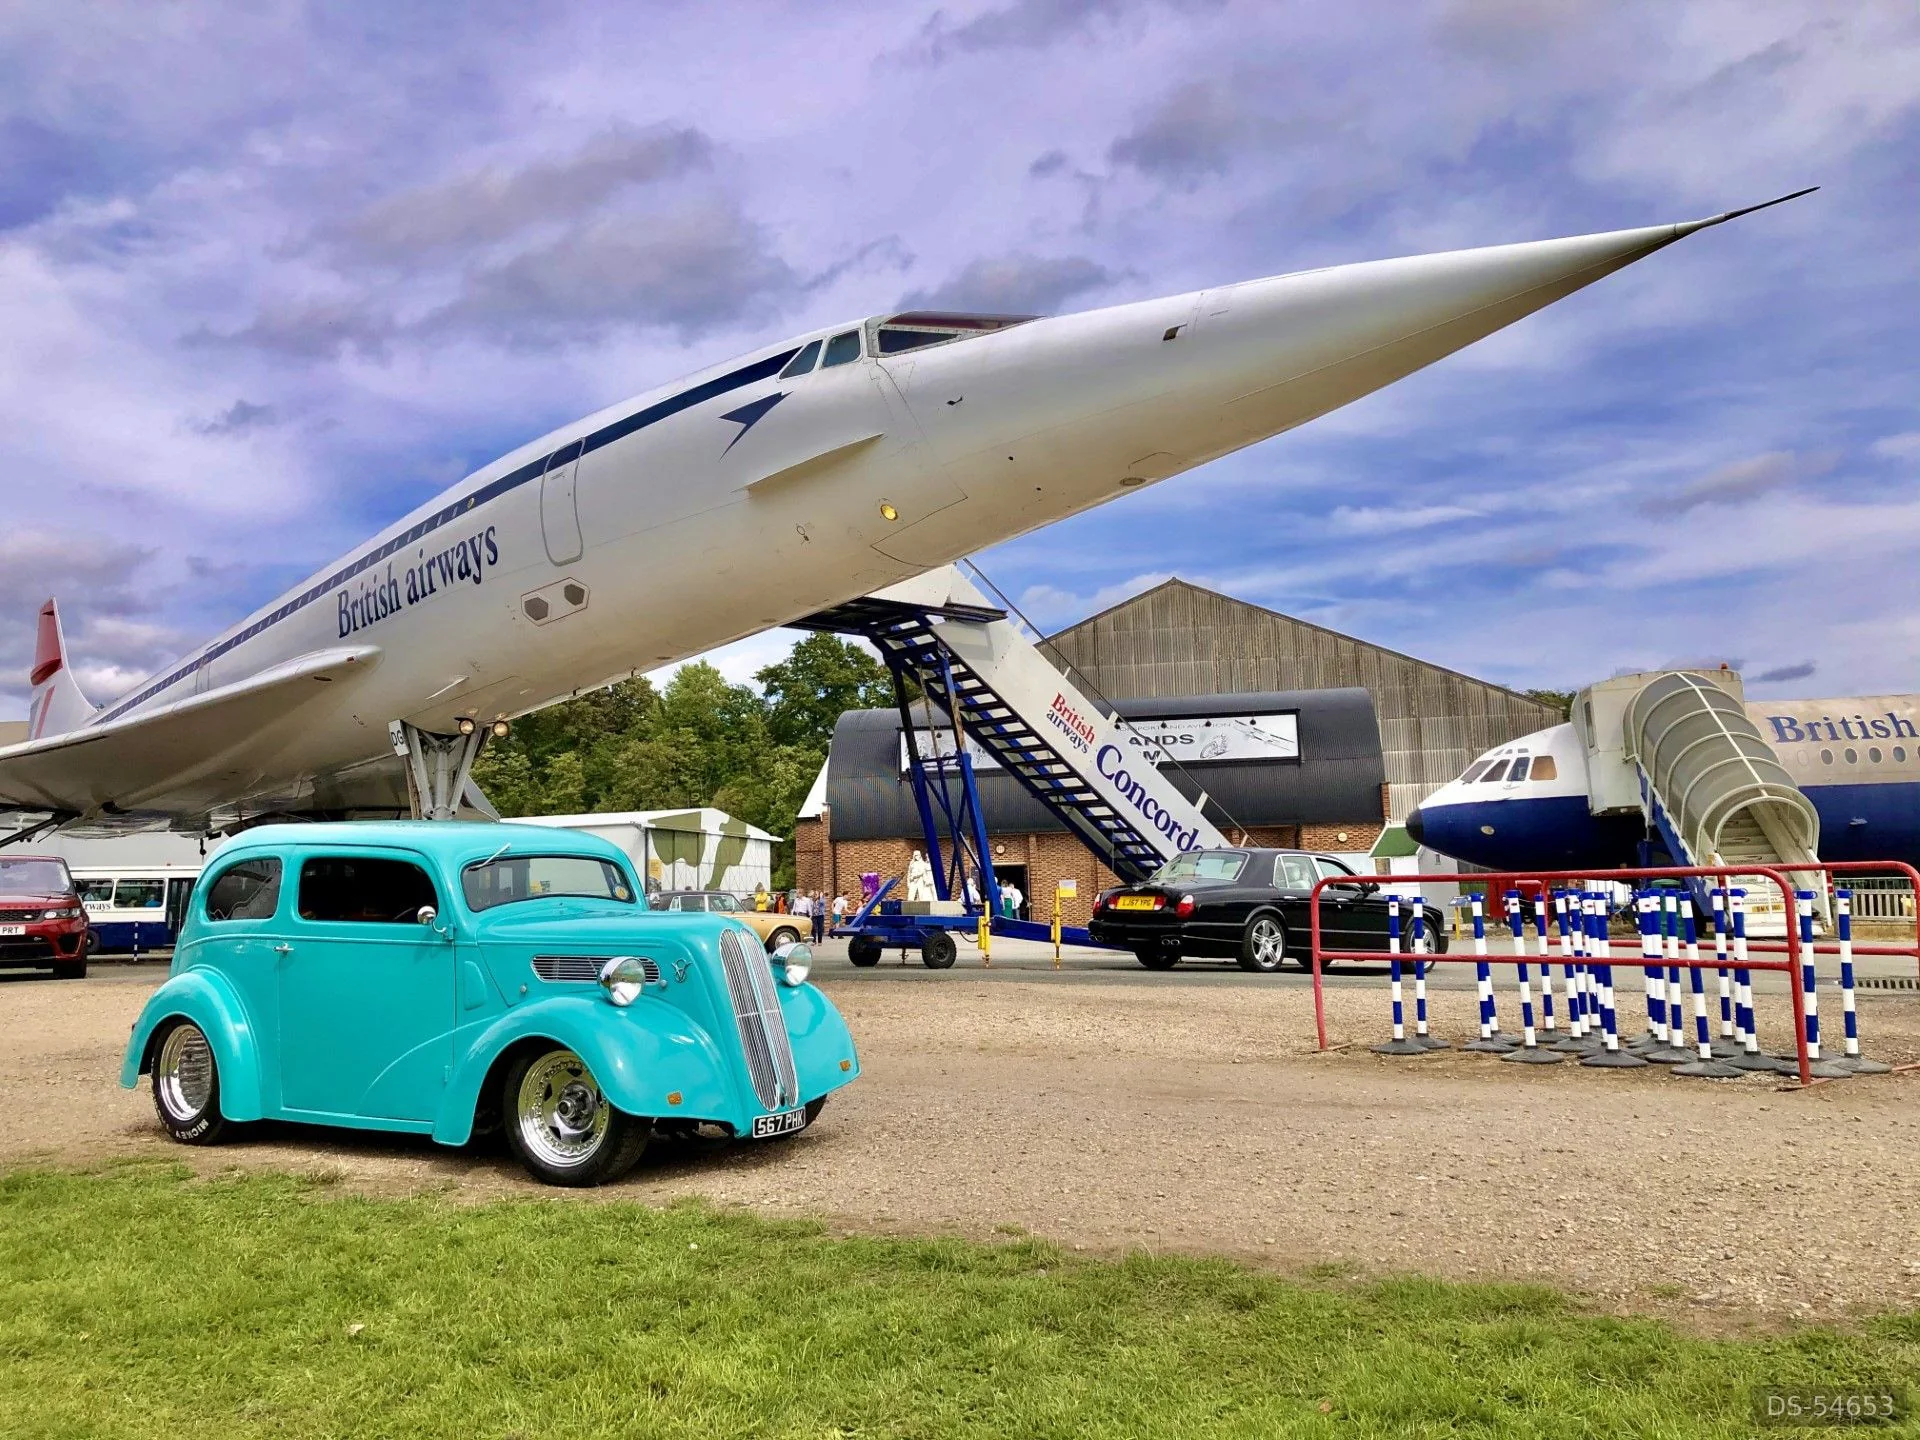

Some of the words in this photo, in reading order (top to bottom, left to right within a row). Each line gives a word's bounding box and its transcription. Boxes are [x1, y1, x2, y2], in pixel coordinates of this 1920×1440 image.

[337, 561, 402, 638] British
[405, 525, 498, 605] airways
[1046, 709, 1090, 754] airways
[1051, 692, 1095, 745] British
[1766, 712, 1919, 743] British
[391, 730, 404, 746] DG
[2, 926, 19, 934] PRT
[175, 1118, 209, 1140] MICKEY
[757, 1116, 783, 1134] 567
[785, 1110, 803, 1129] PHK
